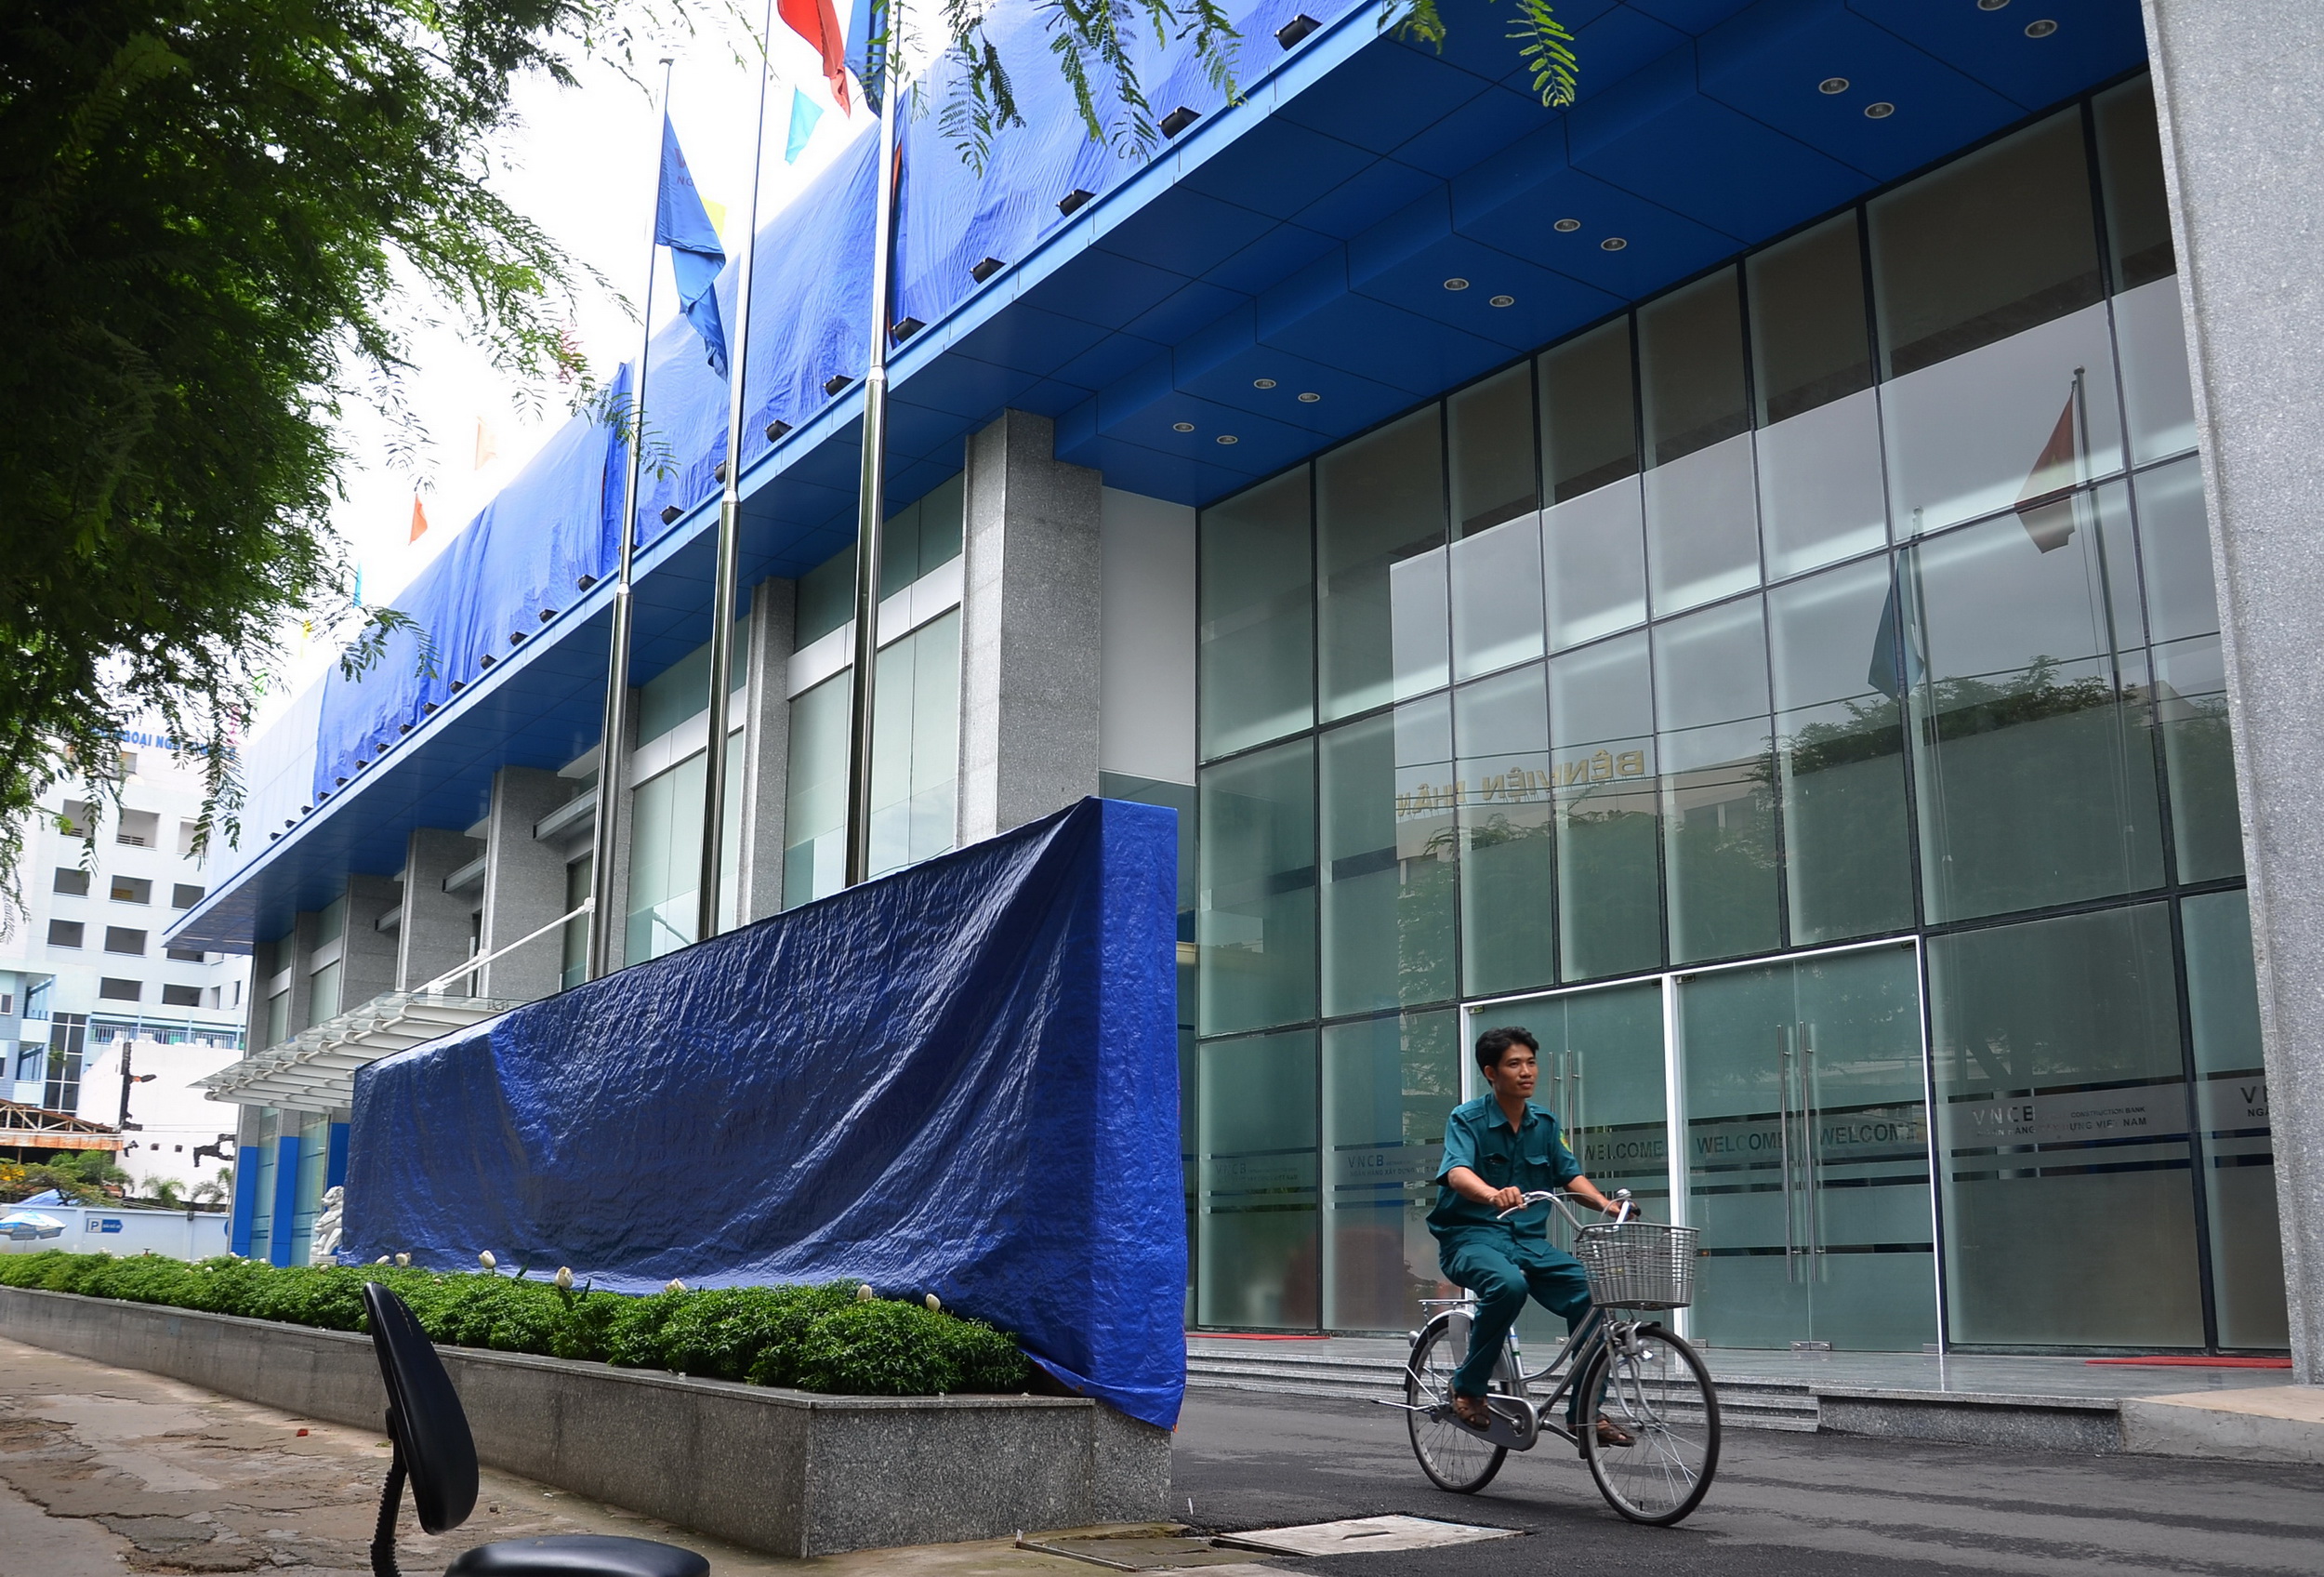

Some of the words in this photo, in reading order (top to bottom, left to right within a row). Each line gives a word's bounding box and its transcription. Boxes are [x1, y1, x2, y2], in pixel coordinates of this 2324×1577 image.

[2239, 1085, 2267, 1104] V
[1972, 1105, 2035, 1125] VNCB
[2070, 1108, 2124, 1119] CONSTRUCTION
[2125, 1107, 2146, 1115] BANK
[2123, 1117, 2146, 1127] NAM
[1819, 1122, 1915, 1146] WELCOM
[1583, 1141, 1663, 1161] WELCOME
[1348, 1155, 1383, 1169] VNCB
[90, 1221, 99, 1231] P
